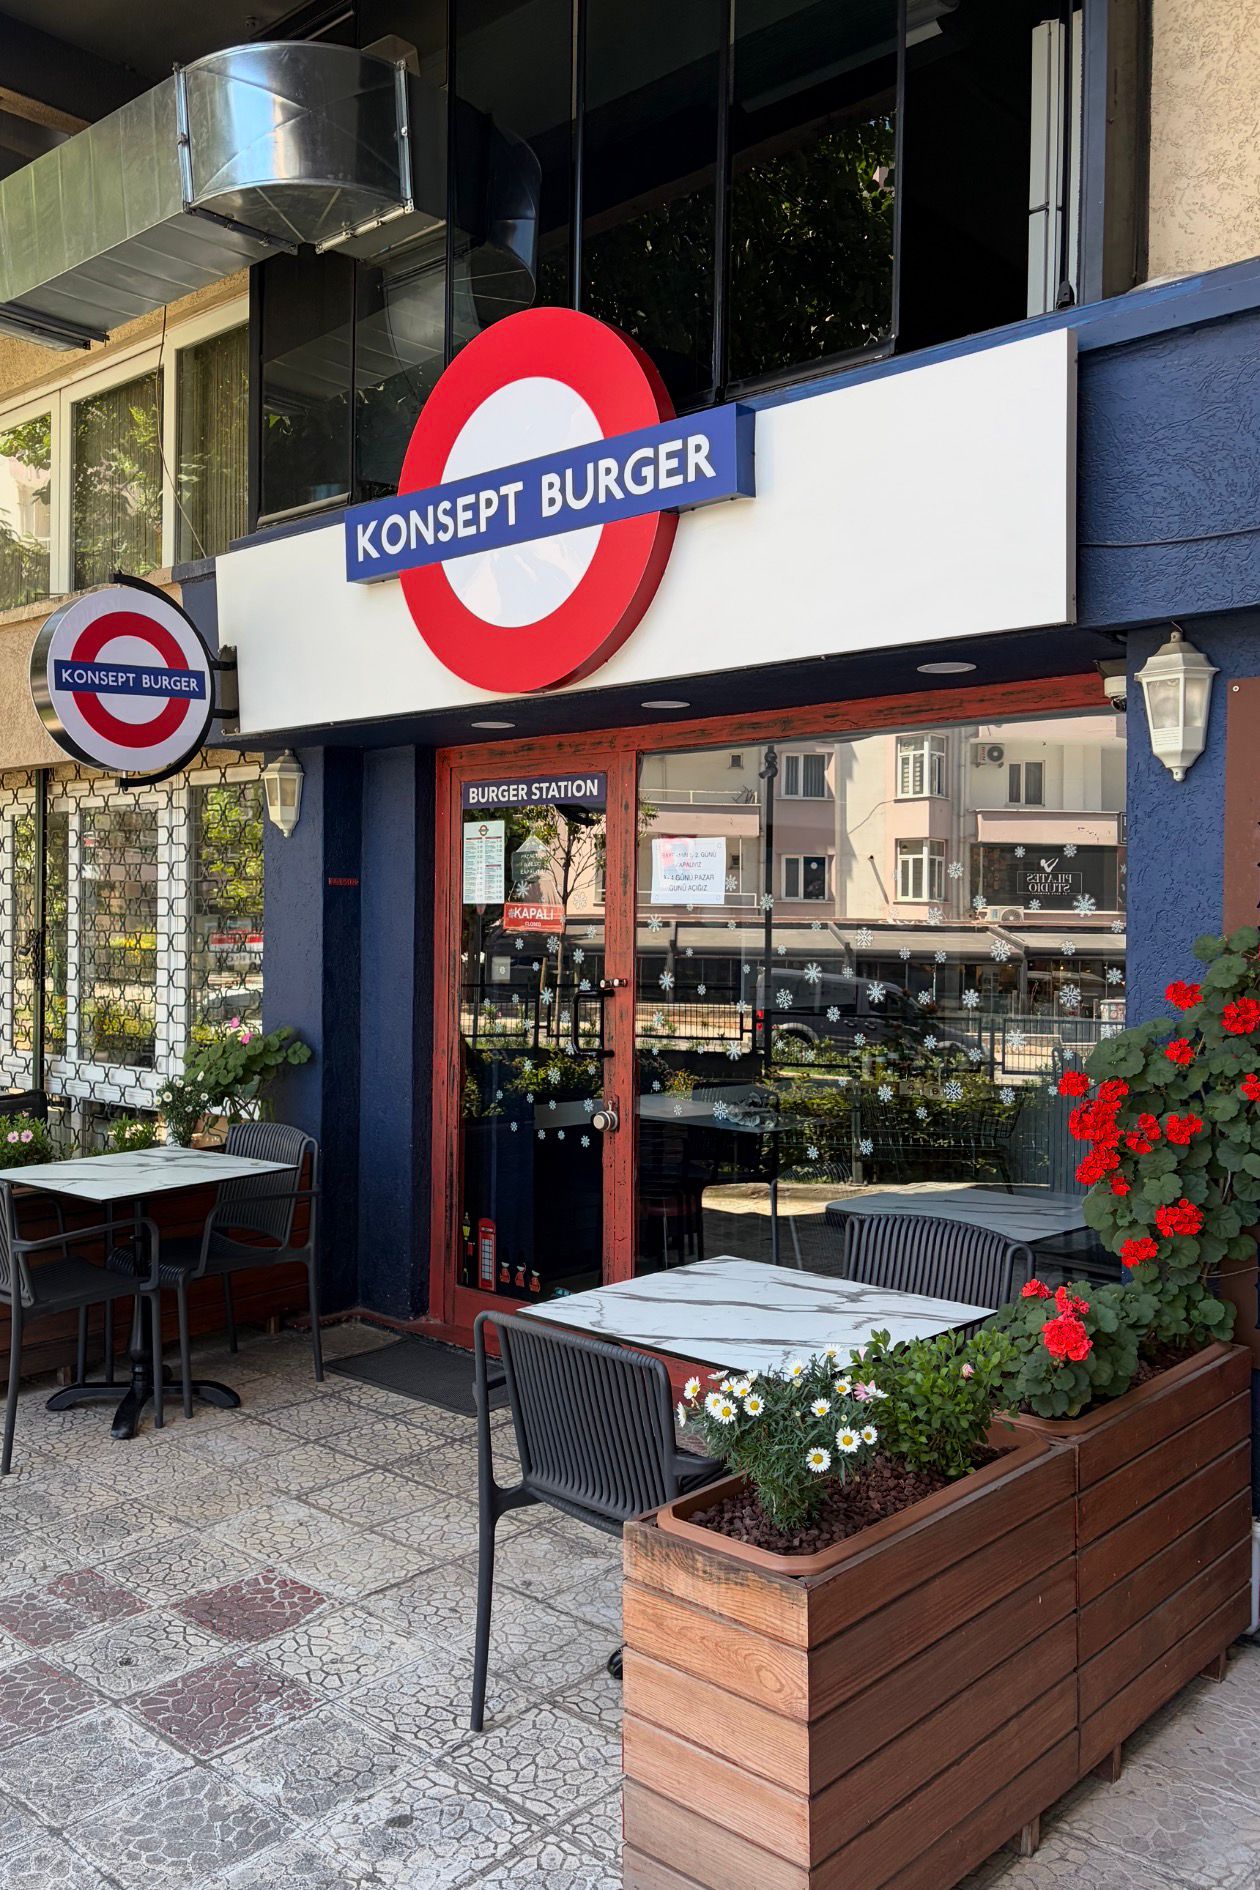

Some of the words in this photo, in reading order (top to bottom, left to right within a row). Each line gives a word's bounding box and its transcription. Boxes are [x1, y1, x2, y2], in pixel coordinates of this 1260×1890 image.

[356, 481, 523, 562] KONSEPT
[541, 433, 716, 518] BURGER
[61, 669, 136, 686] KONSEPT
[142, 675, 199, 691] BURGER
[469, 784, 528, 804] BURGER
[531, 779, 598, 800] STATION
[514, 907, 554, 920] KAPALI
